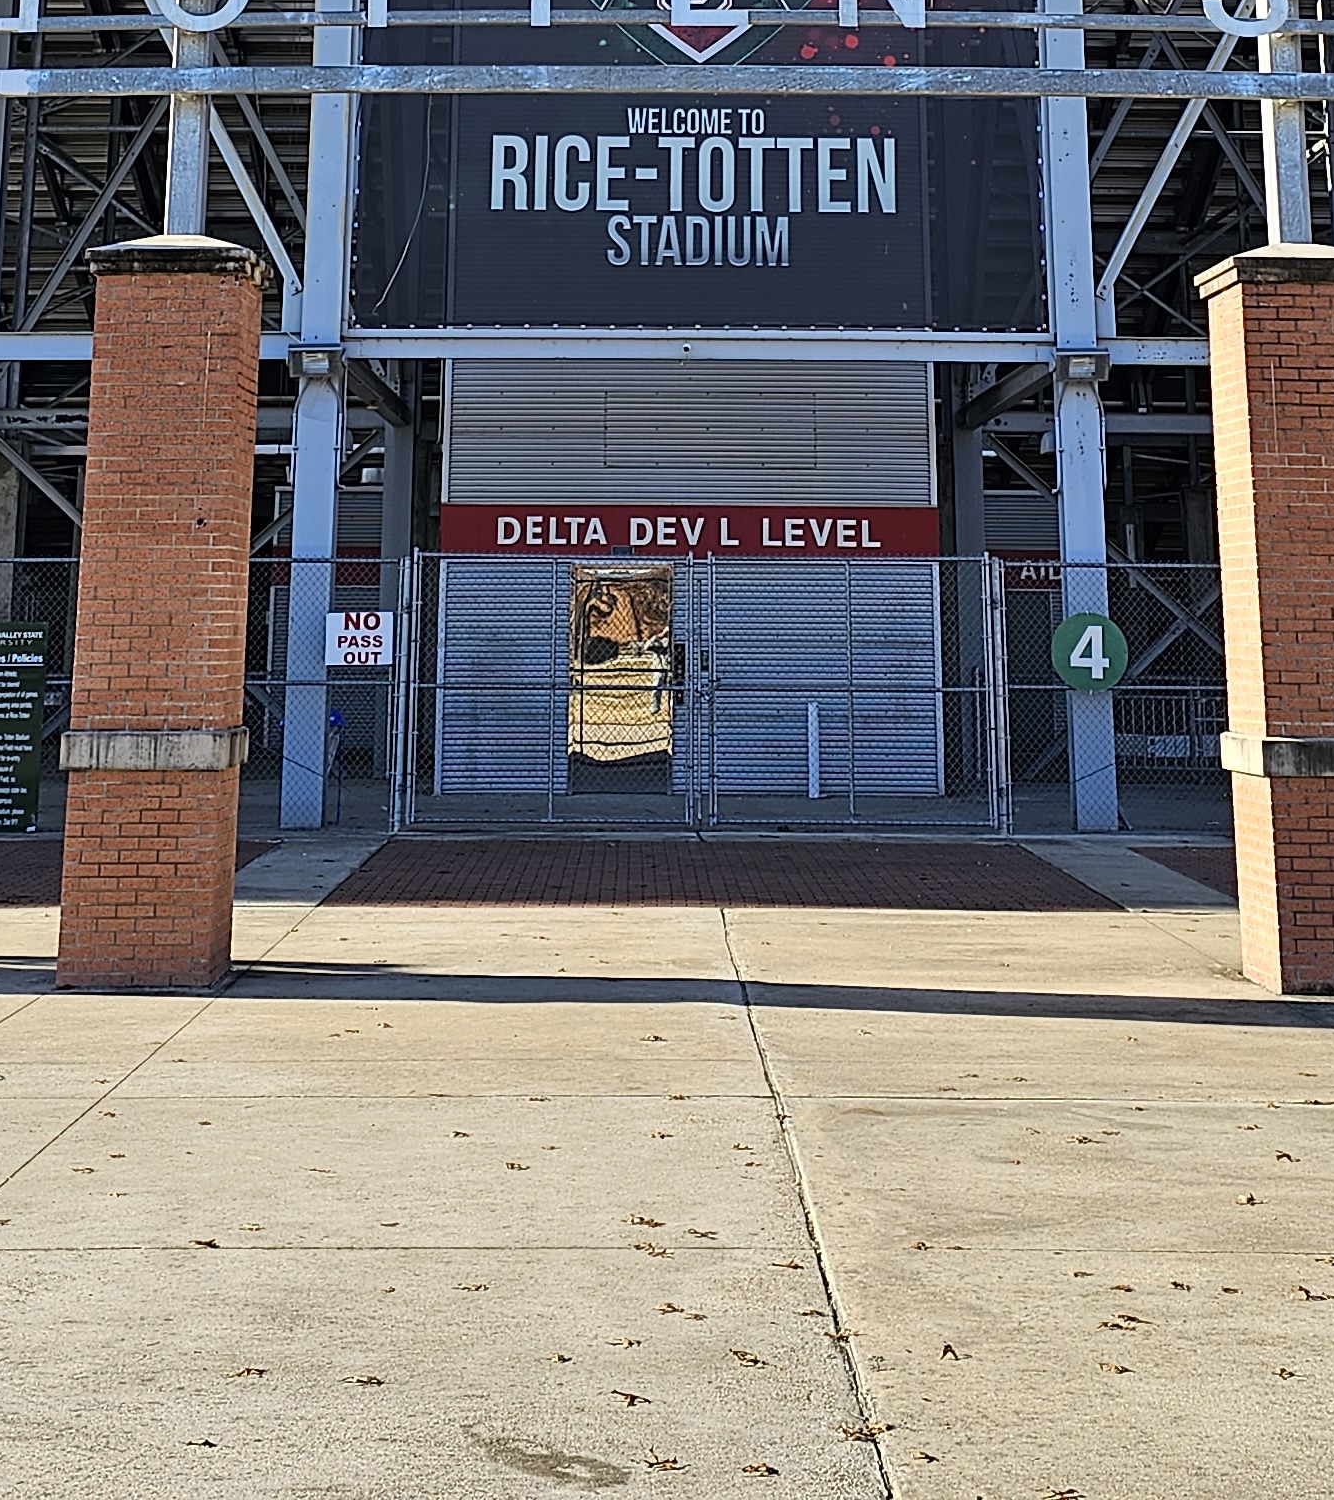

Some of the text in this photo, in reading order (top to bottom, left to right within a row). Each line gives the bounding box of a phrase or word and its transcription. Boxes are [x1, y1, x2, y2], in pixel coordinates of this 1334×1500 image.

[627, 106, 766, 135] WELCOME TO
[489, 134, 898, 214] RICE-TOTTEN
[606, 214, 790, 267] STADIUM
[496, 515, 608, 546] DELTA
[761, 516, 882, 548] LEVEL
[344, 612, 381, 631] NO
[22, 631, 44, 639] STATE
[337, 634, 383, 649] PASS
[12, 652, 44, 663] Policies
[343, 651, 382, 665] OUT
[1069, 625, 1110, 680] 4
